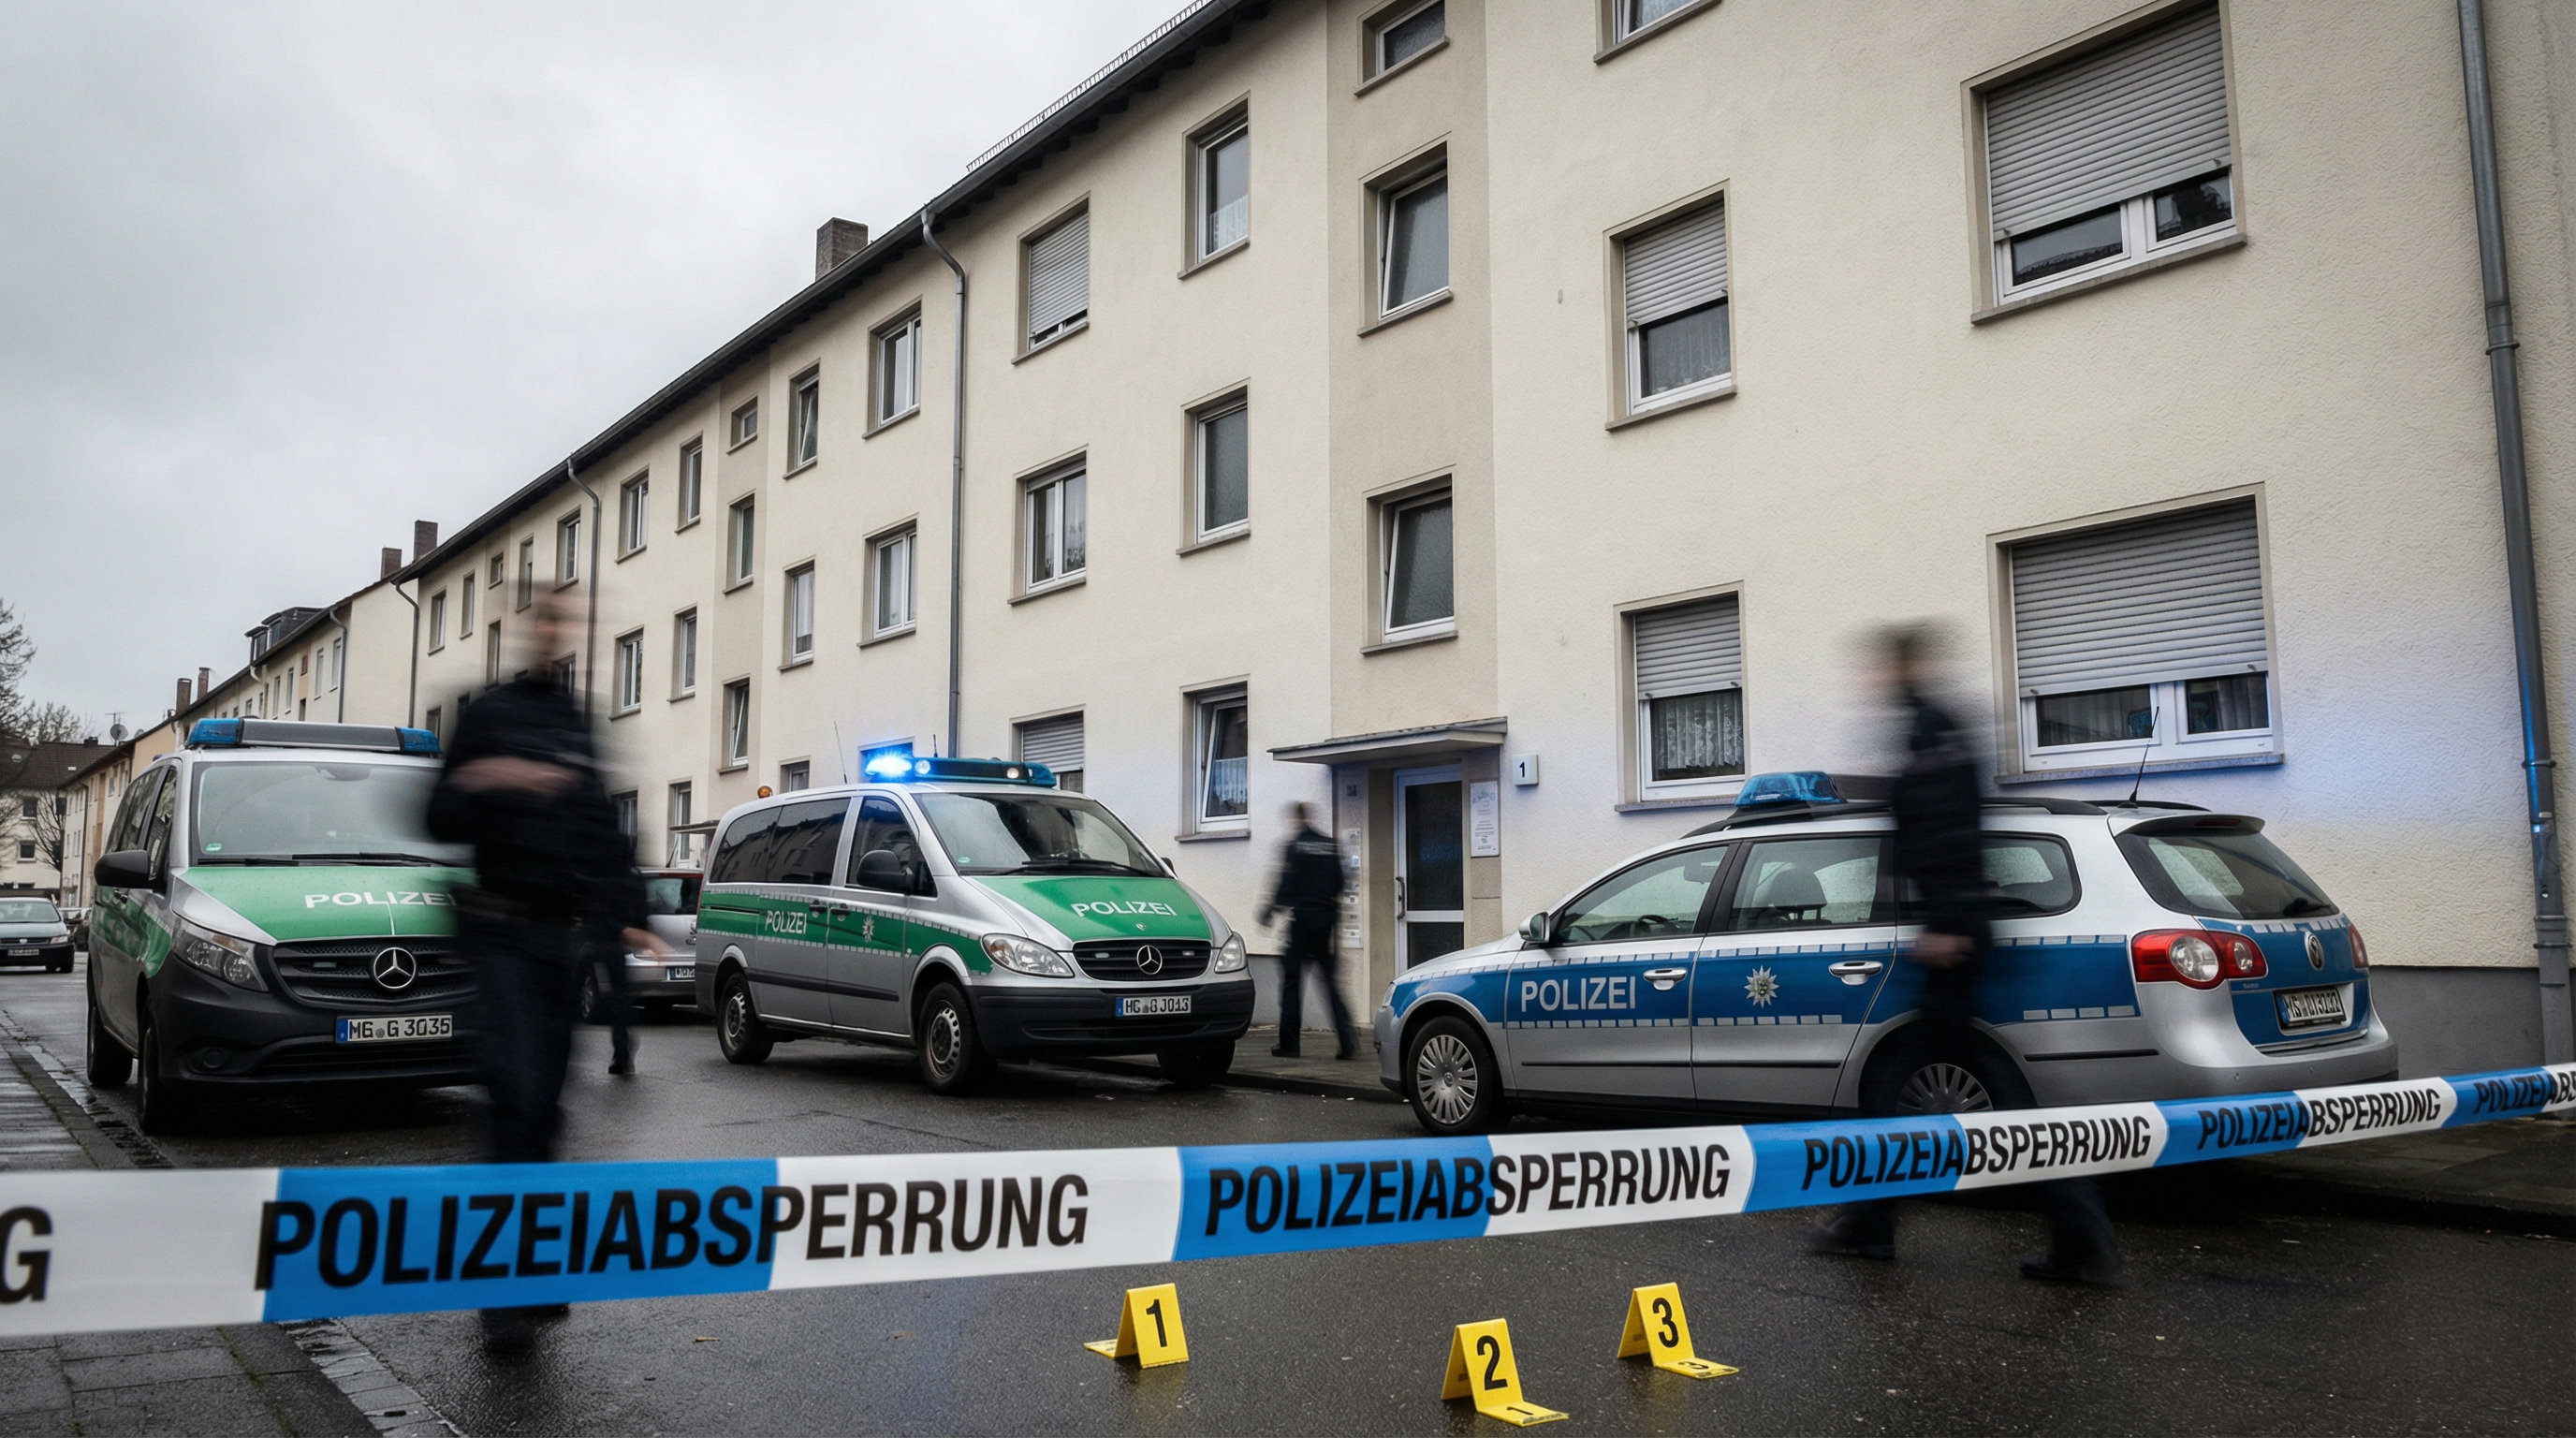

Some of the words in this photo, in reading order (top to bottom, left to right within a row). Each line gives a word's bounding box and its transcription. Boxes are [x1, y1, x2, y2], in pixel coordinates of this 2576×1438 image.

[1519, 761, 1525, 778] 1
[304, 891, 457, 909] POLIZEI
[1070, 901, 1178, 917] POLIZEI
[764, 910, 807, 934] POLIZEI
[1521, 976, 1636, 1012] POLIZEI
[349, 1020, 373, 1039] MG
[387, 1020, 400, 1037] G
[254, 1174, 1089, 1290] POLIZEIABSPERRUNG
[1205, 1144, 1731, 1236] POLIZEIABSPERRUNG
[1801, 1115, 2152, 1191] POLIZEIABSPERRUNG
[2197, 1088, 2441, 1151] POLIZEIABSPERRUNG
[1146, 1299, 1168, 1348] 1
[1652, 1297, 1680, 1348] 3
[1476, 1335, 1508, 1391] 2
